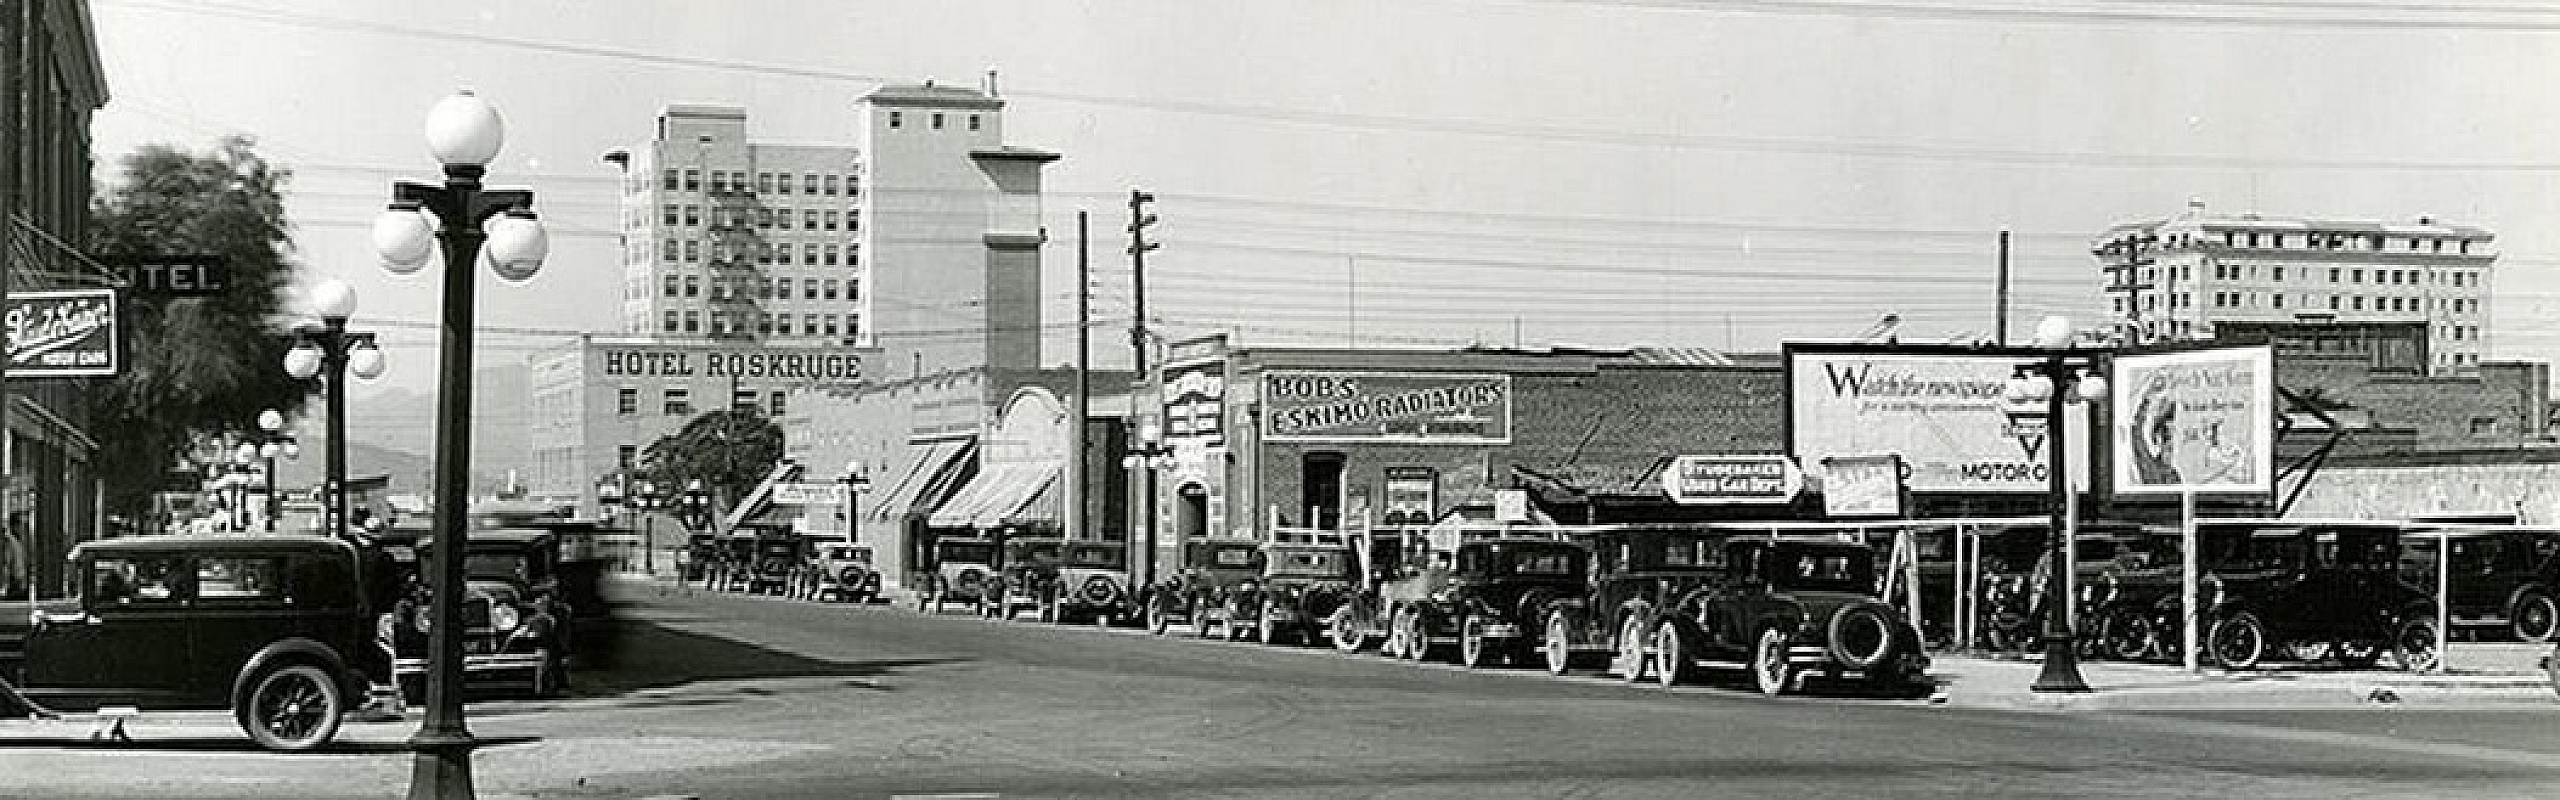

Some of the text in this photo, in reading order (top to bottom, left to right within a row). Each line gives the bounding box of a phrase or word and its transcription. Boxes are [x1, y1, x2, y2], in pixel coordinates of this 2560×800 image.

[113, 264, 222, 291] OTEL
[605, 350, 863, 380] HOTEL ROSKRUGE
[1825, 361, 1898, 398] Watch
[1272, 402, 1371, 434] ESKIMO
[1374, 381, 1506, 420] RADIATORS
[1961, 461, 2031, 483] MOTOR
